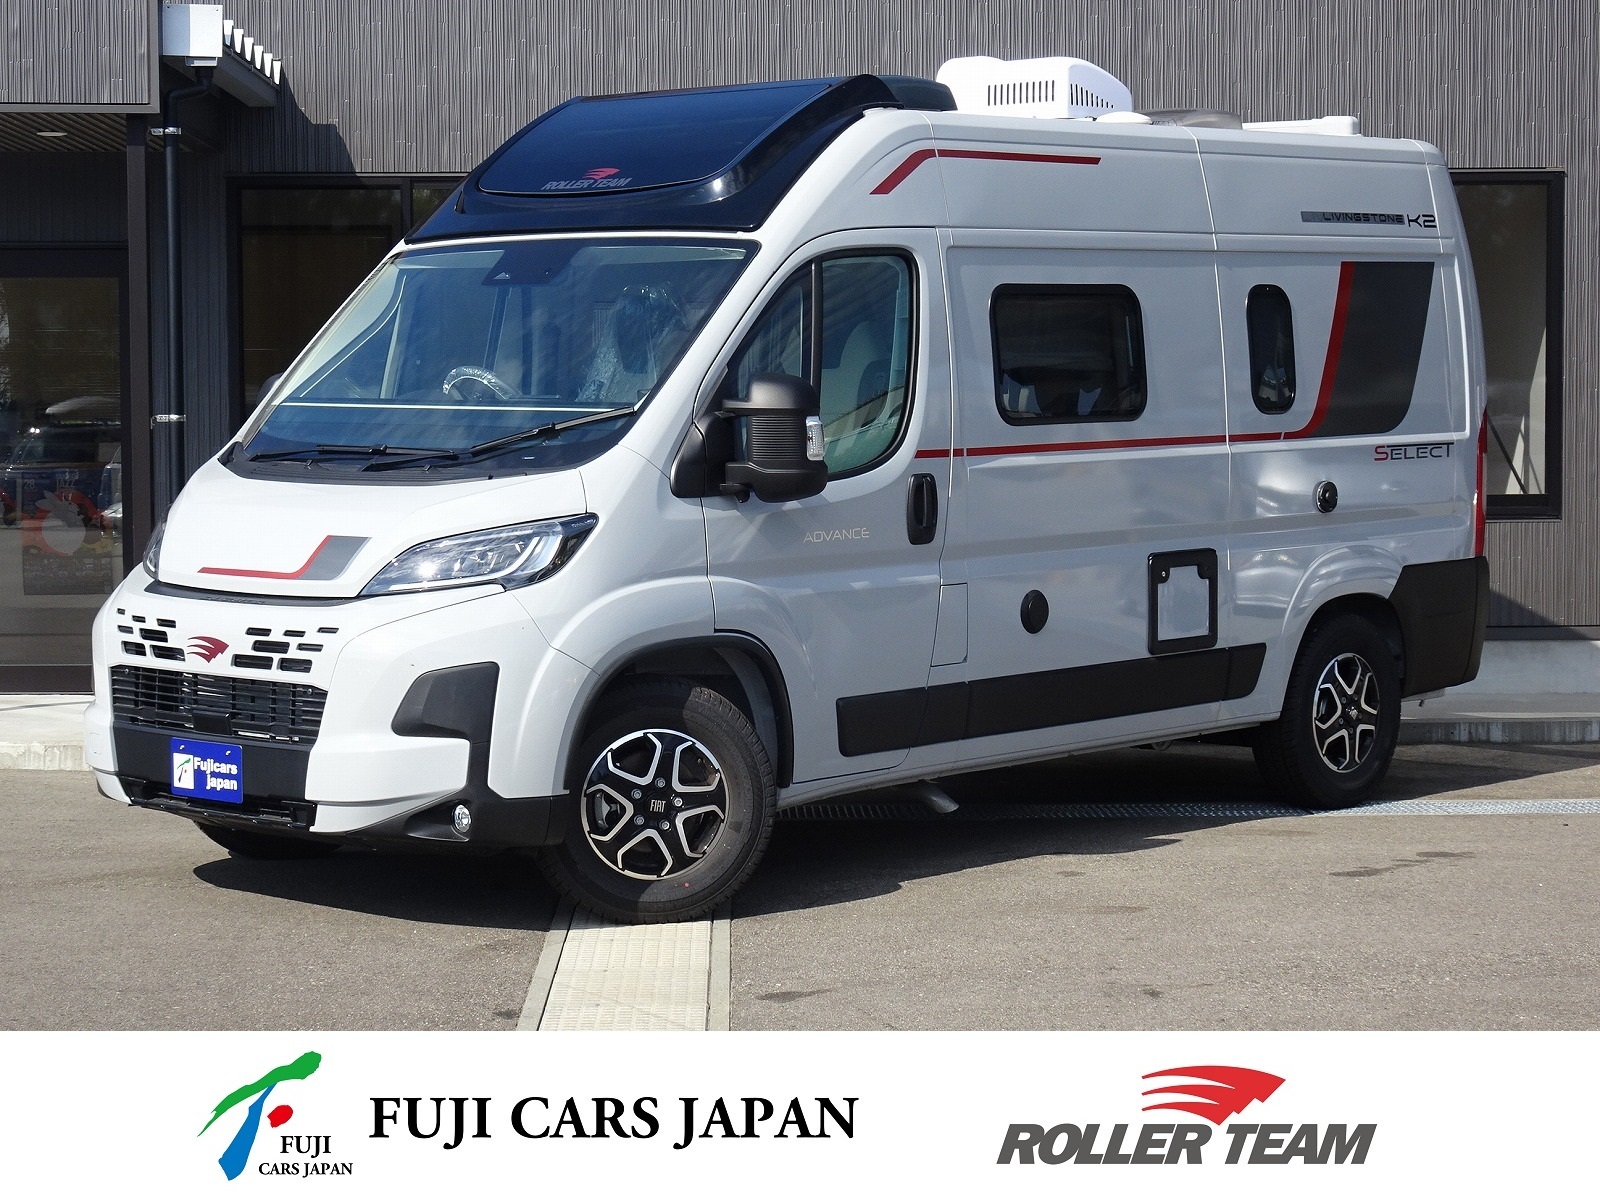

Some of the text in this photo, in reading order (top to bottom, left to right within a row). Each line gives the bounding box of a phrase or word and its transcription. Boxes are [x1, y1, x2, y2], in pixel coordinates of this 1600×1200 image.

[541, 178, 633, 190] ROLLER TEAM
[1322, 212, 1437, 228] LIVINGSTONE K2
[803, 527, 870, 543] ADVANCE
[194, 757, 238, 775] Fujicars
[206, 774, 238, 791] japan
[650, 799, 667, 813] FIAT
